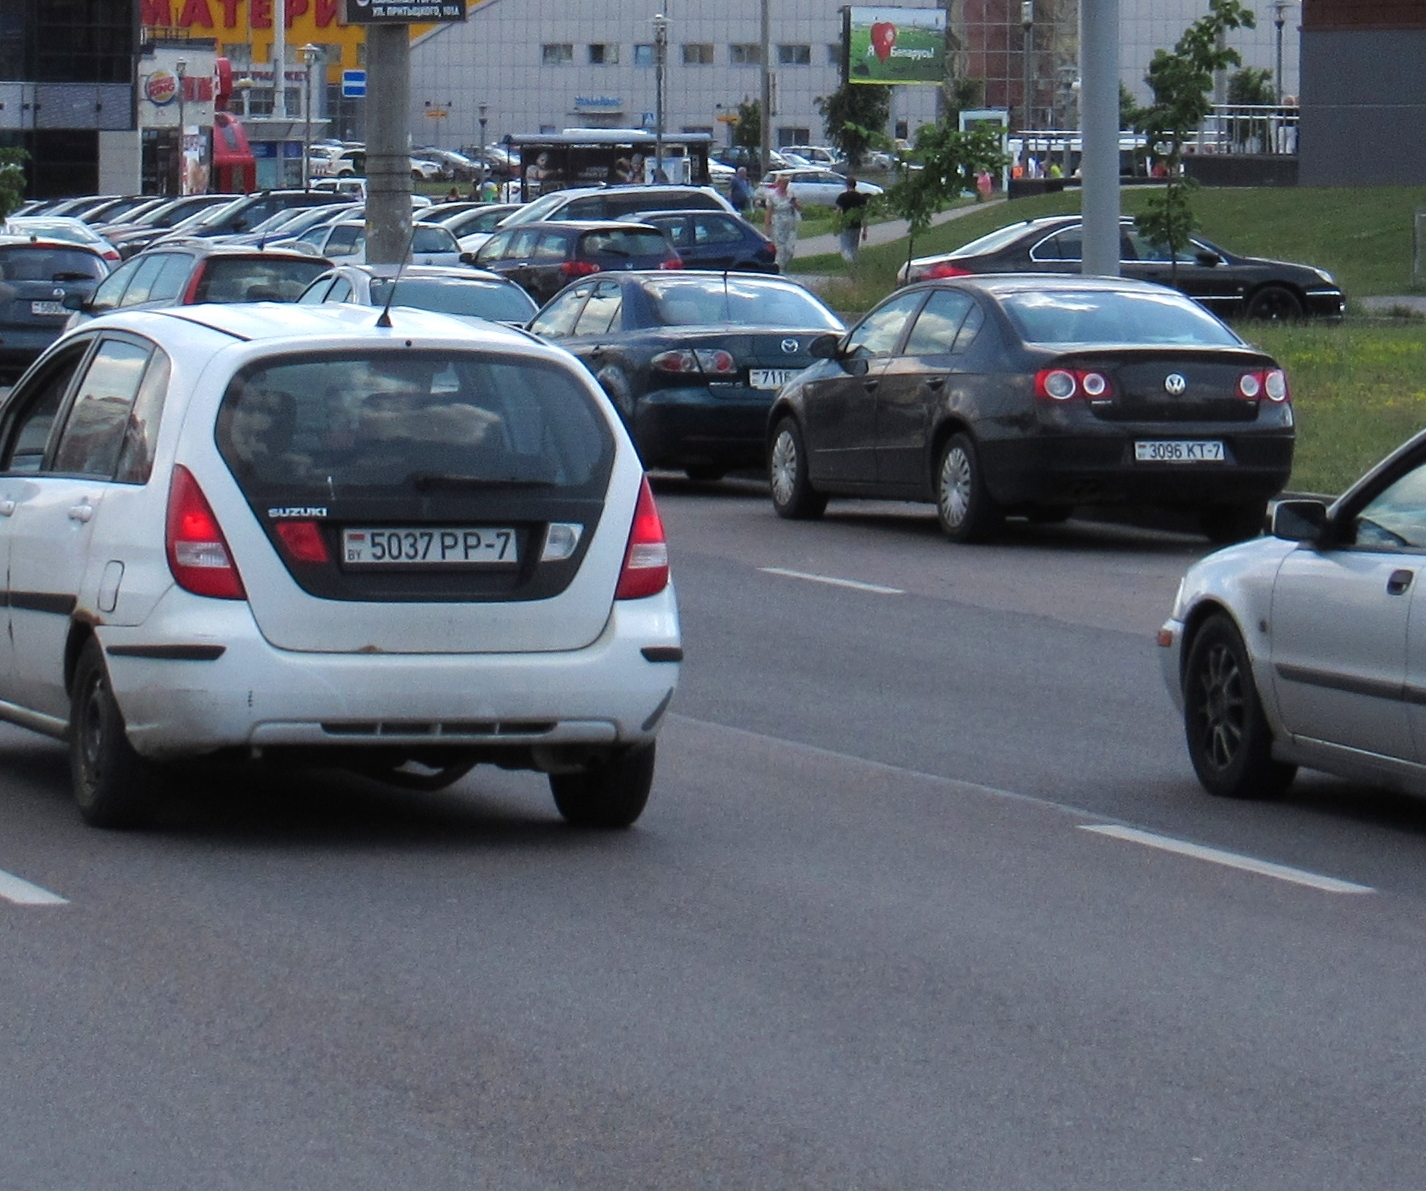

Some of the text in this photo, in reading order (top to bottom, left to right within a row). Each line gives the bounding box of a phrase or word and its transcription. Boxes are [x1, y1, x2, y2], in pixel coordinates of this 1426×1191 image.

[868, 45, 875, 56] Я
[1150, 444, 1221, 459] 3096 KT-7
[268, 507, 327, 518] SUZUKI
[371, 532, 512, 560] 5037 PP-7
[348, 549, 362, 560] BY
